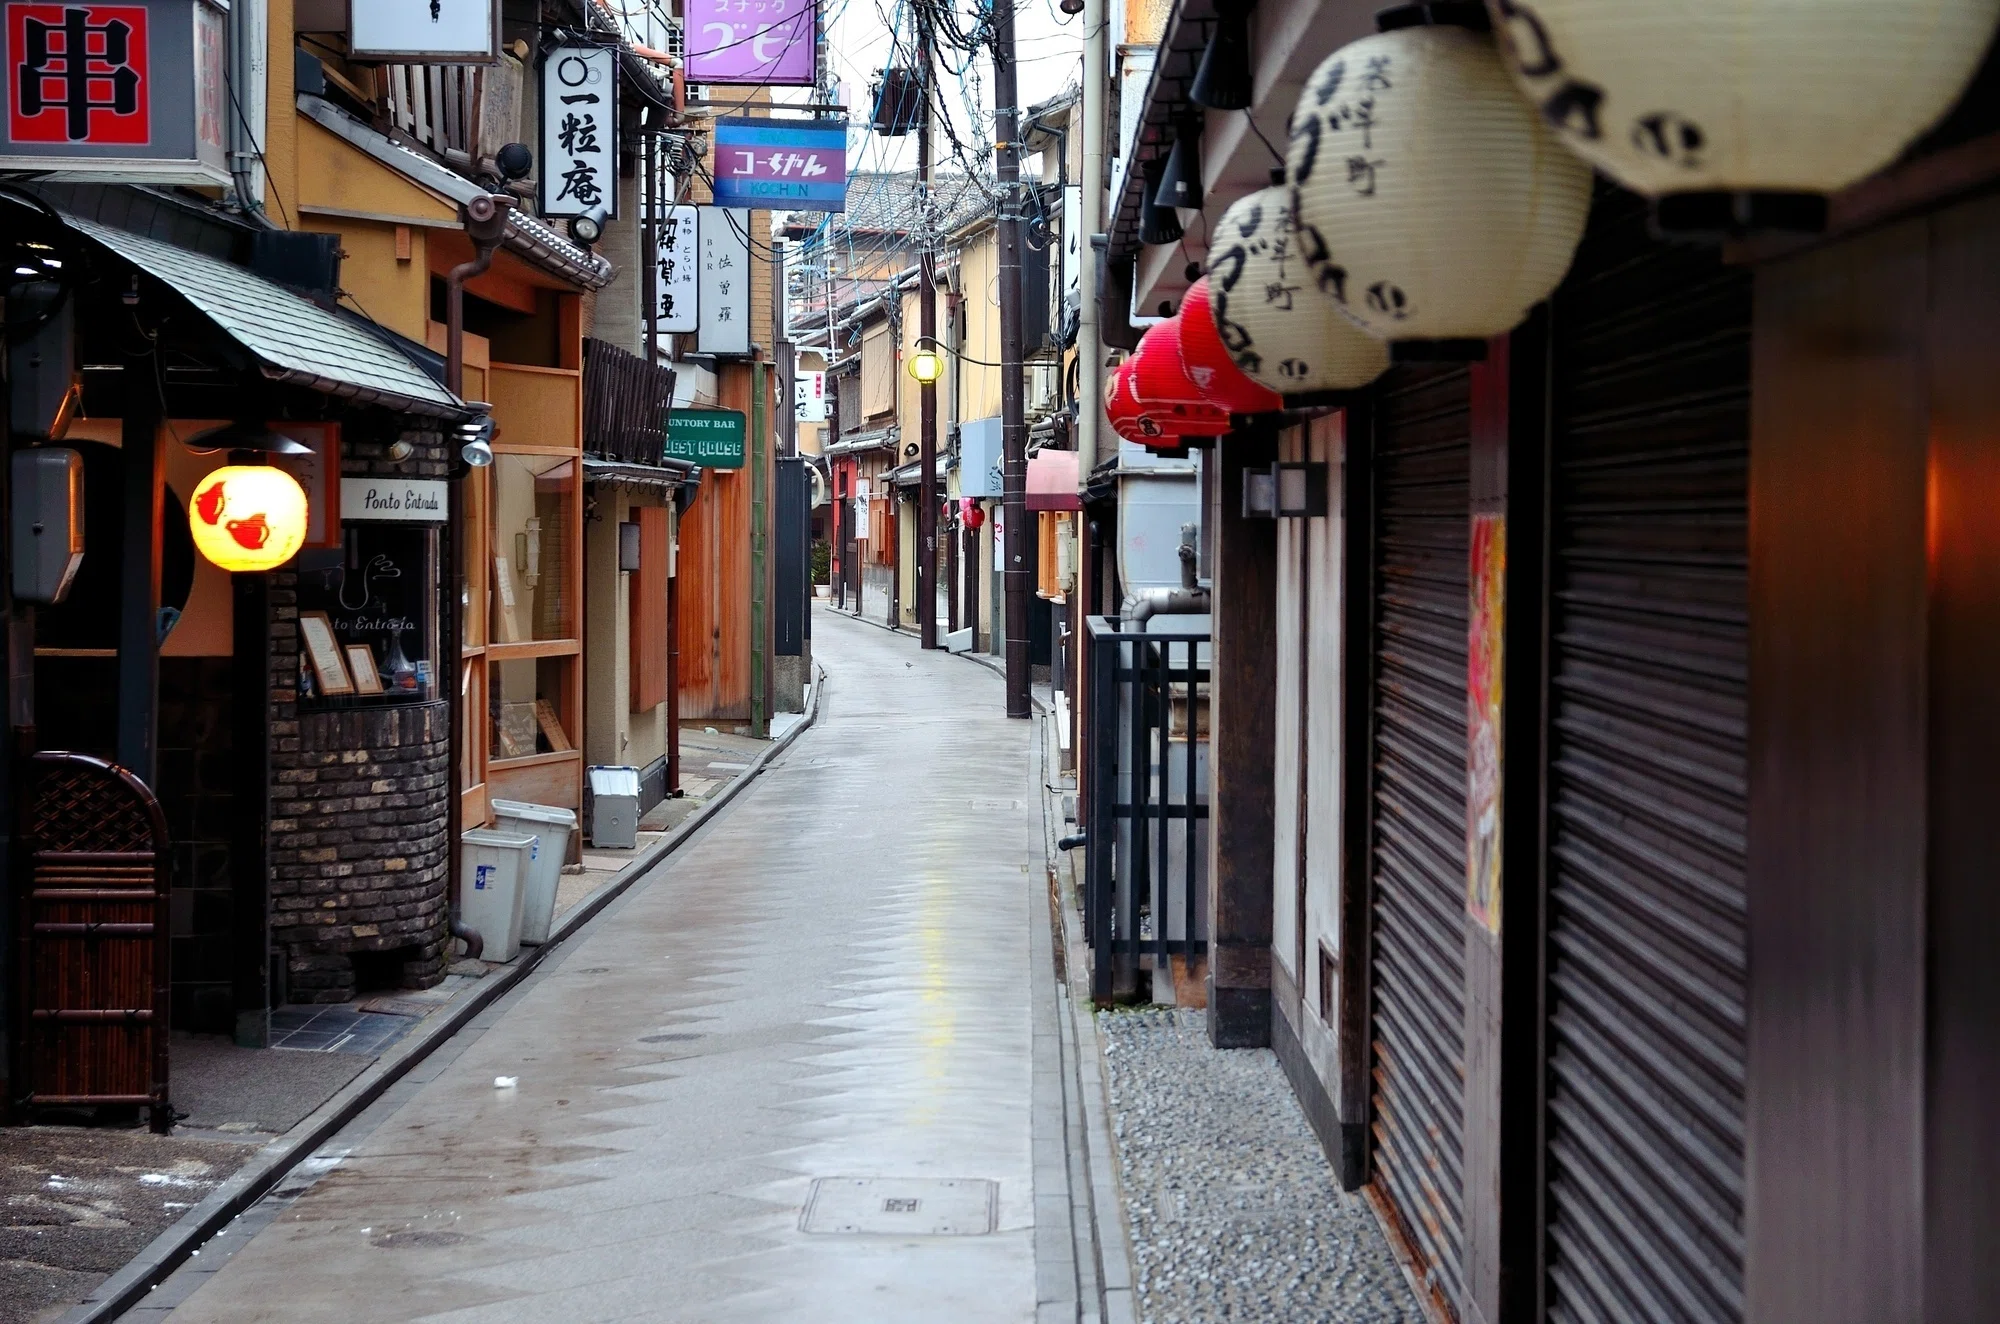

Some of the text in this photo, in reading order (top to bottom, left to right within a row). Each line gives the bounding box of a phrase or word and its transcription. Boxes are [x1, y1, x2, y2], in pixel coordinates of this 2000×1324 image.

[19, 7, 140, 141] 串
[556, 92, 602, 205] 一粒庵
[732, 151, 828, 177] コーちゃん
[664, 418, 736, 429] UNTORY BAR
[663, 440, 741, 457] UEST HOUSE
[365, 489, 438, 510] Ponto Entrada
